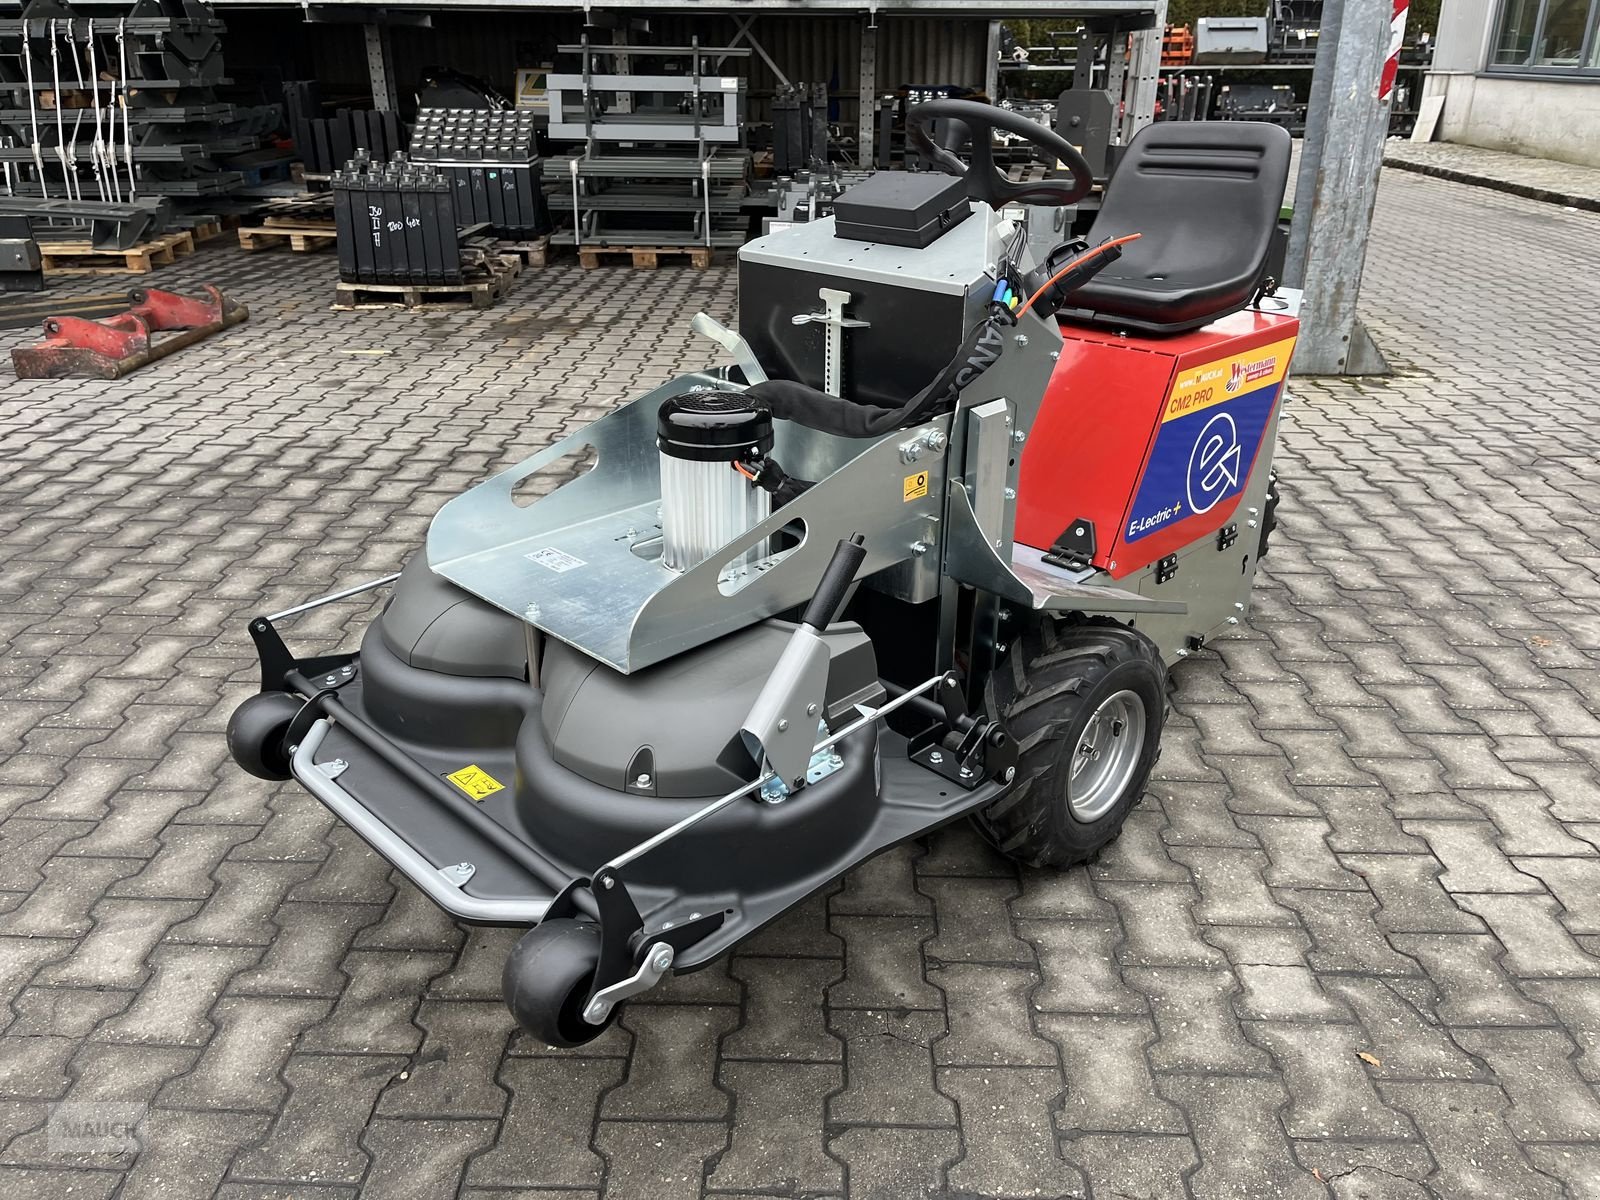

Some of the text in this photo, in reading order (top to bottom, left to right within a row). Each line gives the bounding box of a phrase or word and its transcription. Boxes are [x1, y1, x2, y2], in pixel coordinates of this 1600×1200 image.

[1170, 387, 1214, 413] CM2 PRO
[1128, 507, 1172, 536] E-Lectric
